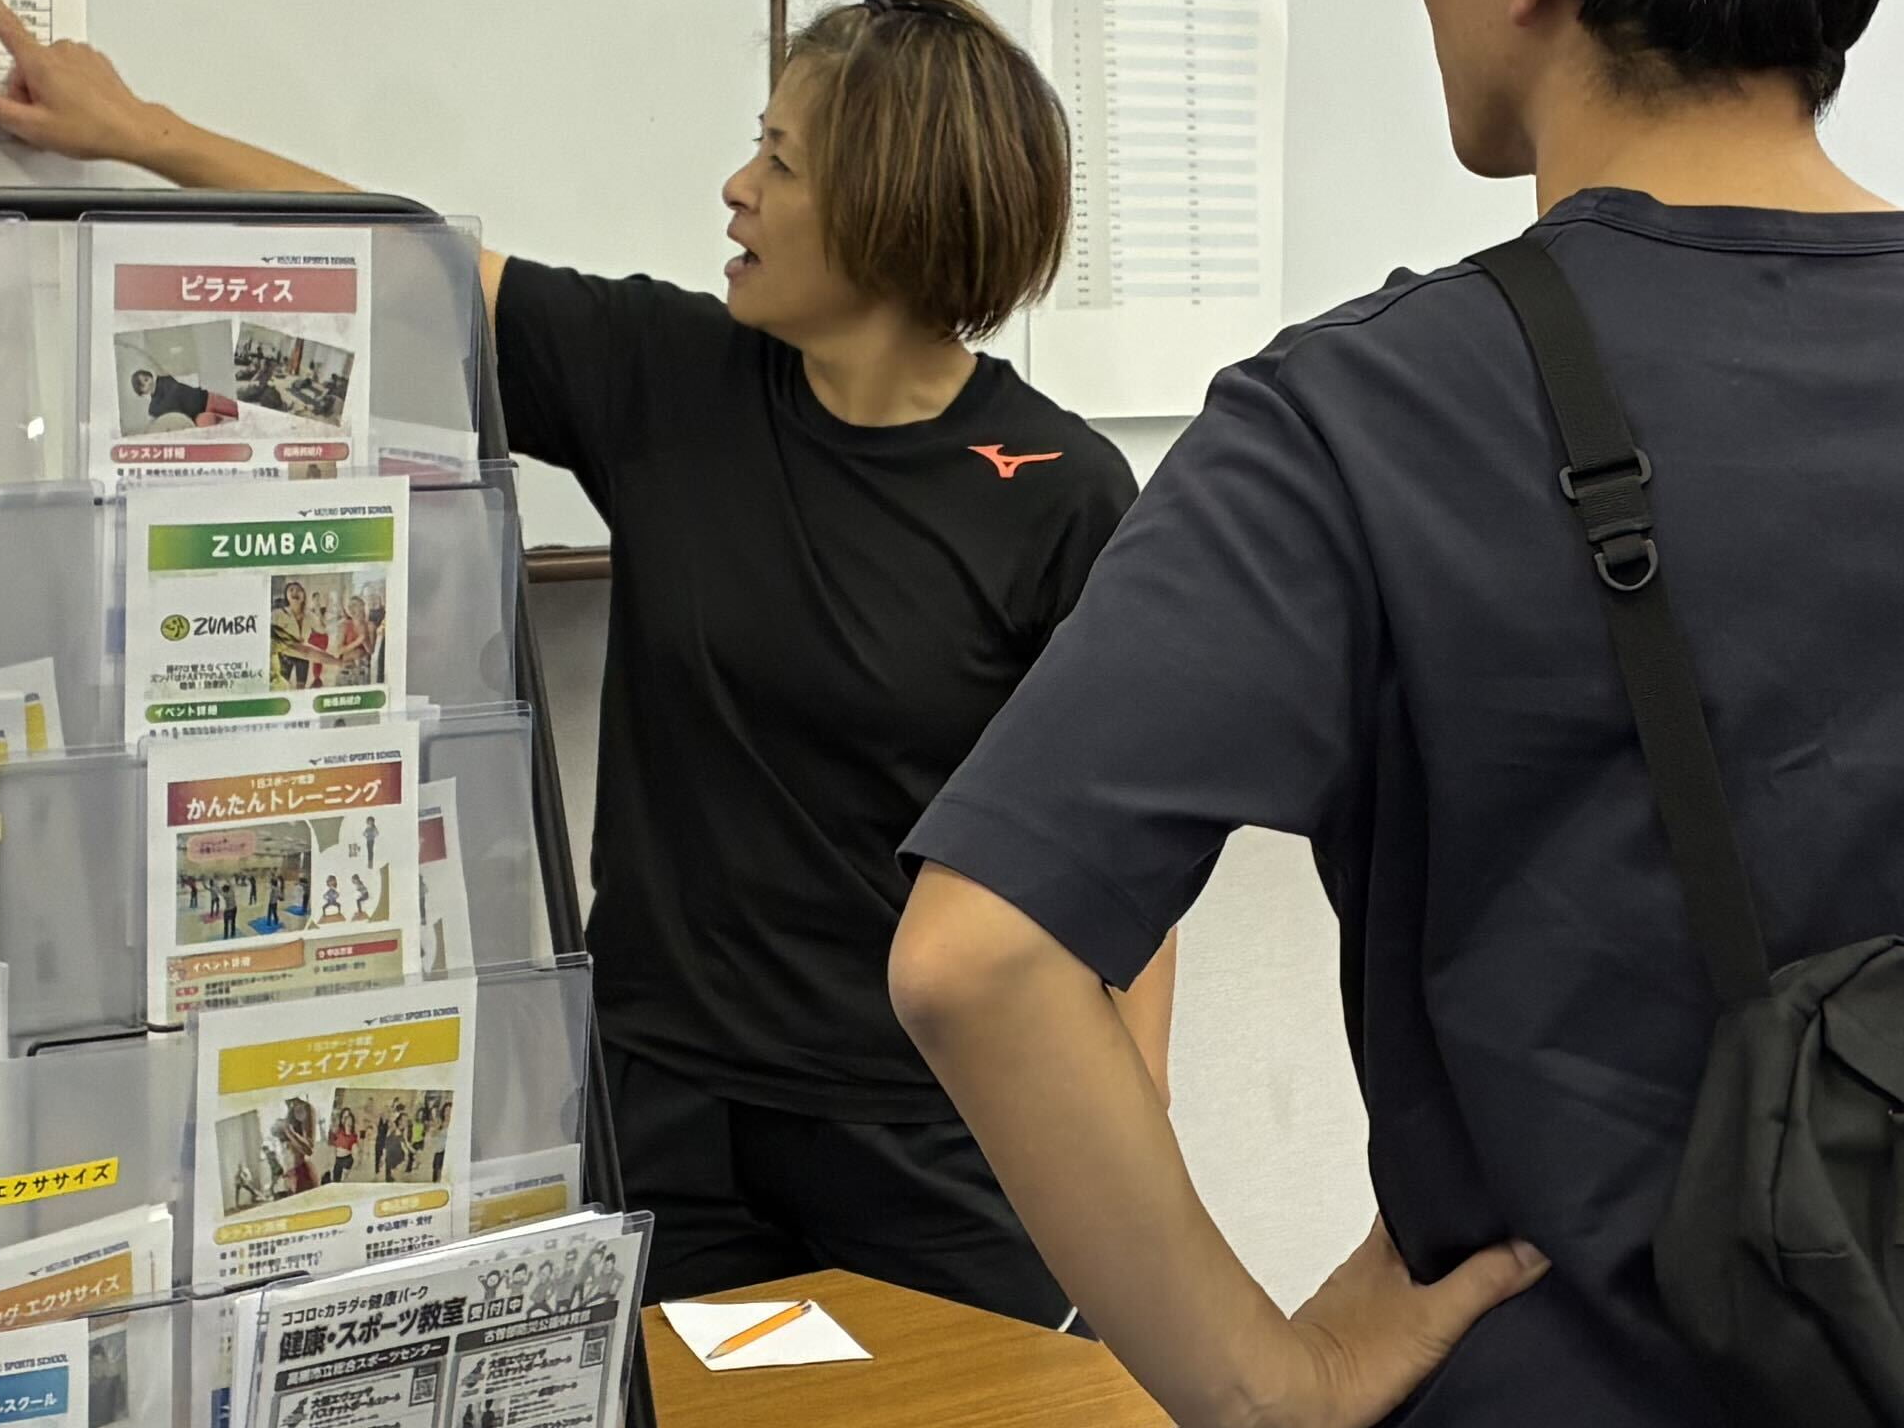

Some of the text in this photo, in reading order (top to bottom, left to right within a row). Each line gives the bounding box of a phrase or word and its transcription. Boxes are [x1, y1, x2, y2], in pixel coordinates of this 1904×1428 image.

[181, 275, 294, 304] ピラティス
[186, 779, 382, 821] かんたんトレーニング
[276, 1041, 411, 1080] シェイプアップ
[25, 1275, 121, 1315] エクササイズ
[278, 1296, 468, 1365] 健康・スポーツ教室
